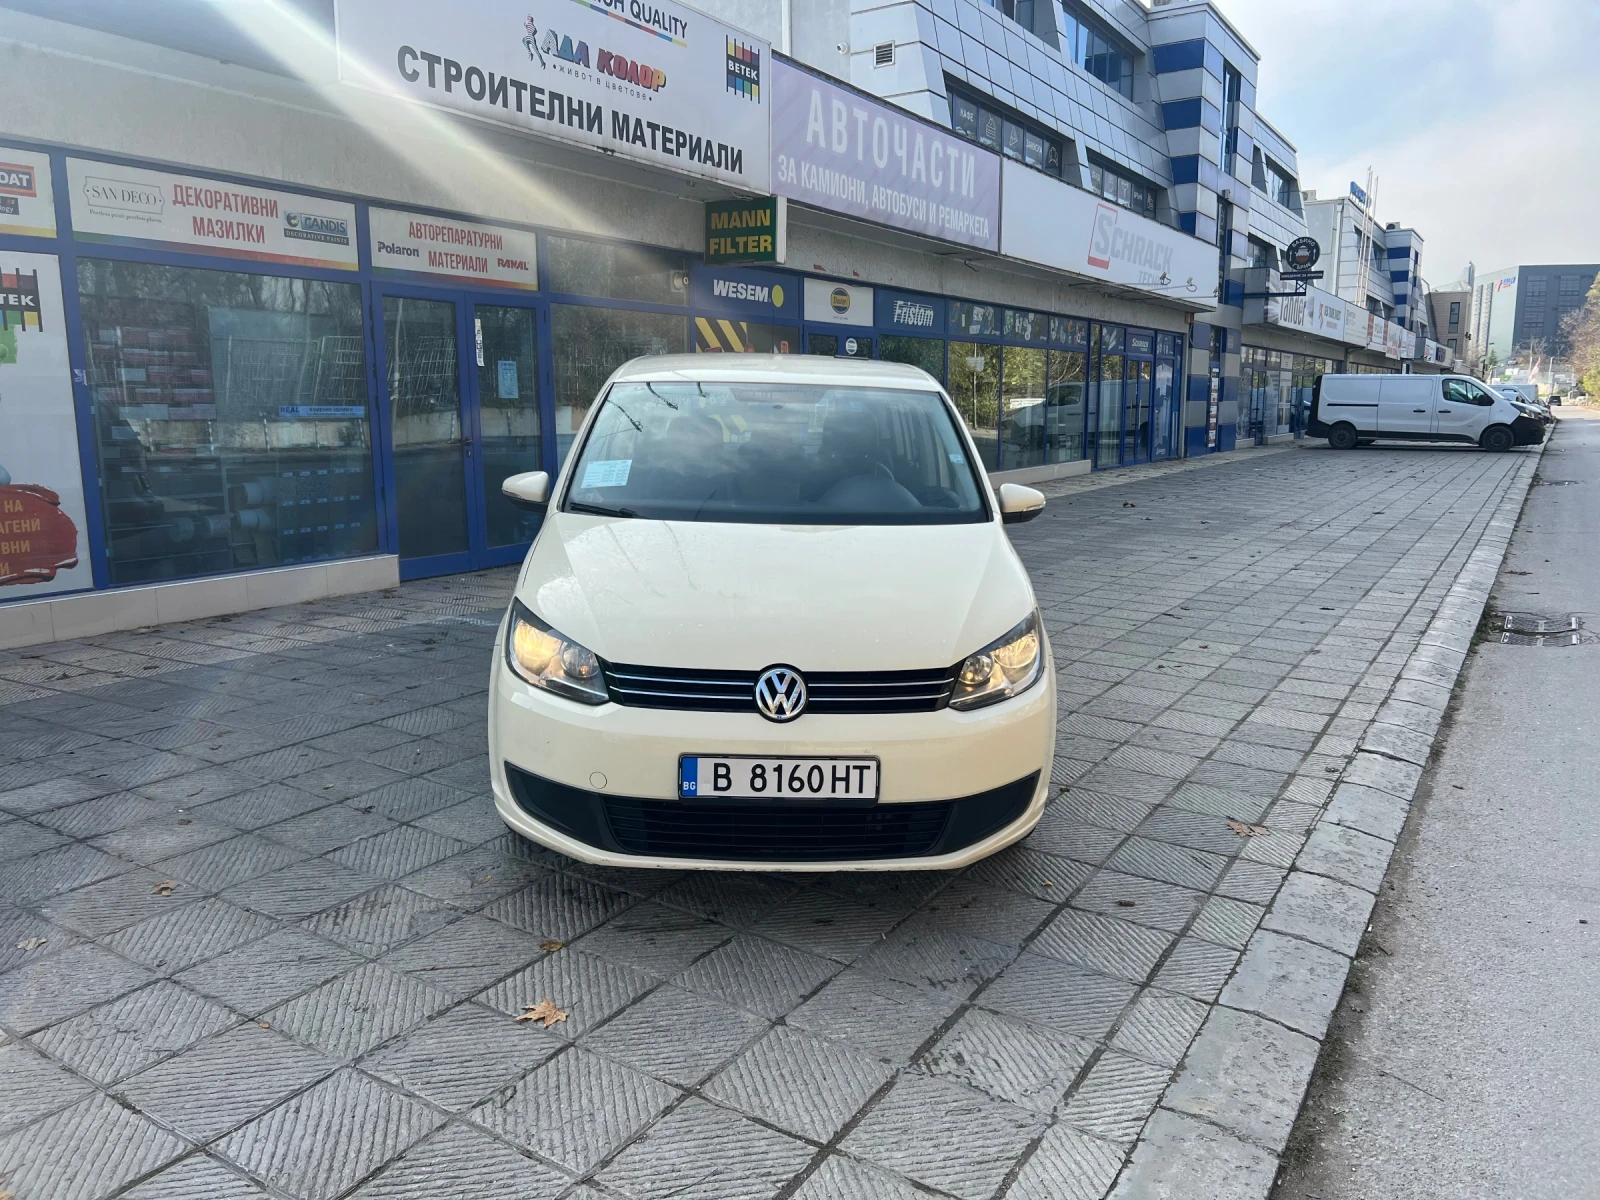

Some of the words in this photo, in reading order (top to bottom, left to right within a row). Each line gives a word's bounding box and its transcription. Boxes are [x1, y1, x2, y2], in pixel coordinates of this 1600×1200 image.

[630, 0, 687, 38] QUALITY
[596, 48, 666, 92] КОЛОР
[728, 60, 758, 81] BETEK
[397, 45, 602, 136] СТРОИТЕЛНИ
[612, 110, 742, 175] МАТЕРИАЛИ
[806, 88, 975, 199] АВТОЧАСТИ
[92, 185, 117, 200] SAN
[121, 189, 157, 206] DECO
[172, 184, 279, 218] ДЕКОРАТИВНИ
[778, 154, 797, 185] ЗА
[801, 162, 868, 209] КАМИОНИ,
[872, 184, 926, 222] АВТОБУСИ
[929, 203, 936, 223] И
[938, 205, 990, 238] РЕМАРКЕТА
[192, 216, 266, 244] МАЗИЛКИ
[711, 209, 771, 230] MANN
[408, 222, 503, 250] АВТОРЕПАРАТУРНИ
[710, 235, 772, 255] FILTER
[1094, 212, 1174, 274] SCHRACK
[1292, 238, 1316, 248] БАБИНО
[378, 241, 420, 258] Polaron
[428, 251, 488, 274] МАТЕРИАЛИ
[497, 258, 529, 271] RANAL
[713, 279, 769, 303] WESEM
[894, 300, 934, 327] Fristom
[280, 406, 300, 414] REAL
[4, 500, 24, 513] НА
[683, 781, 696, 791] BG
[713, 762, 732, 792] B
